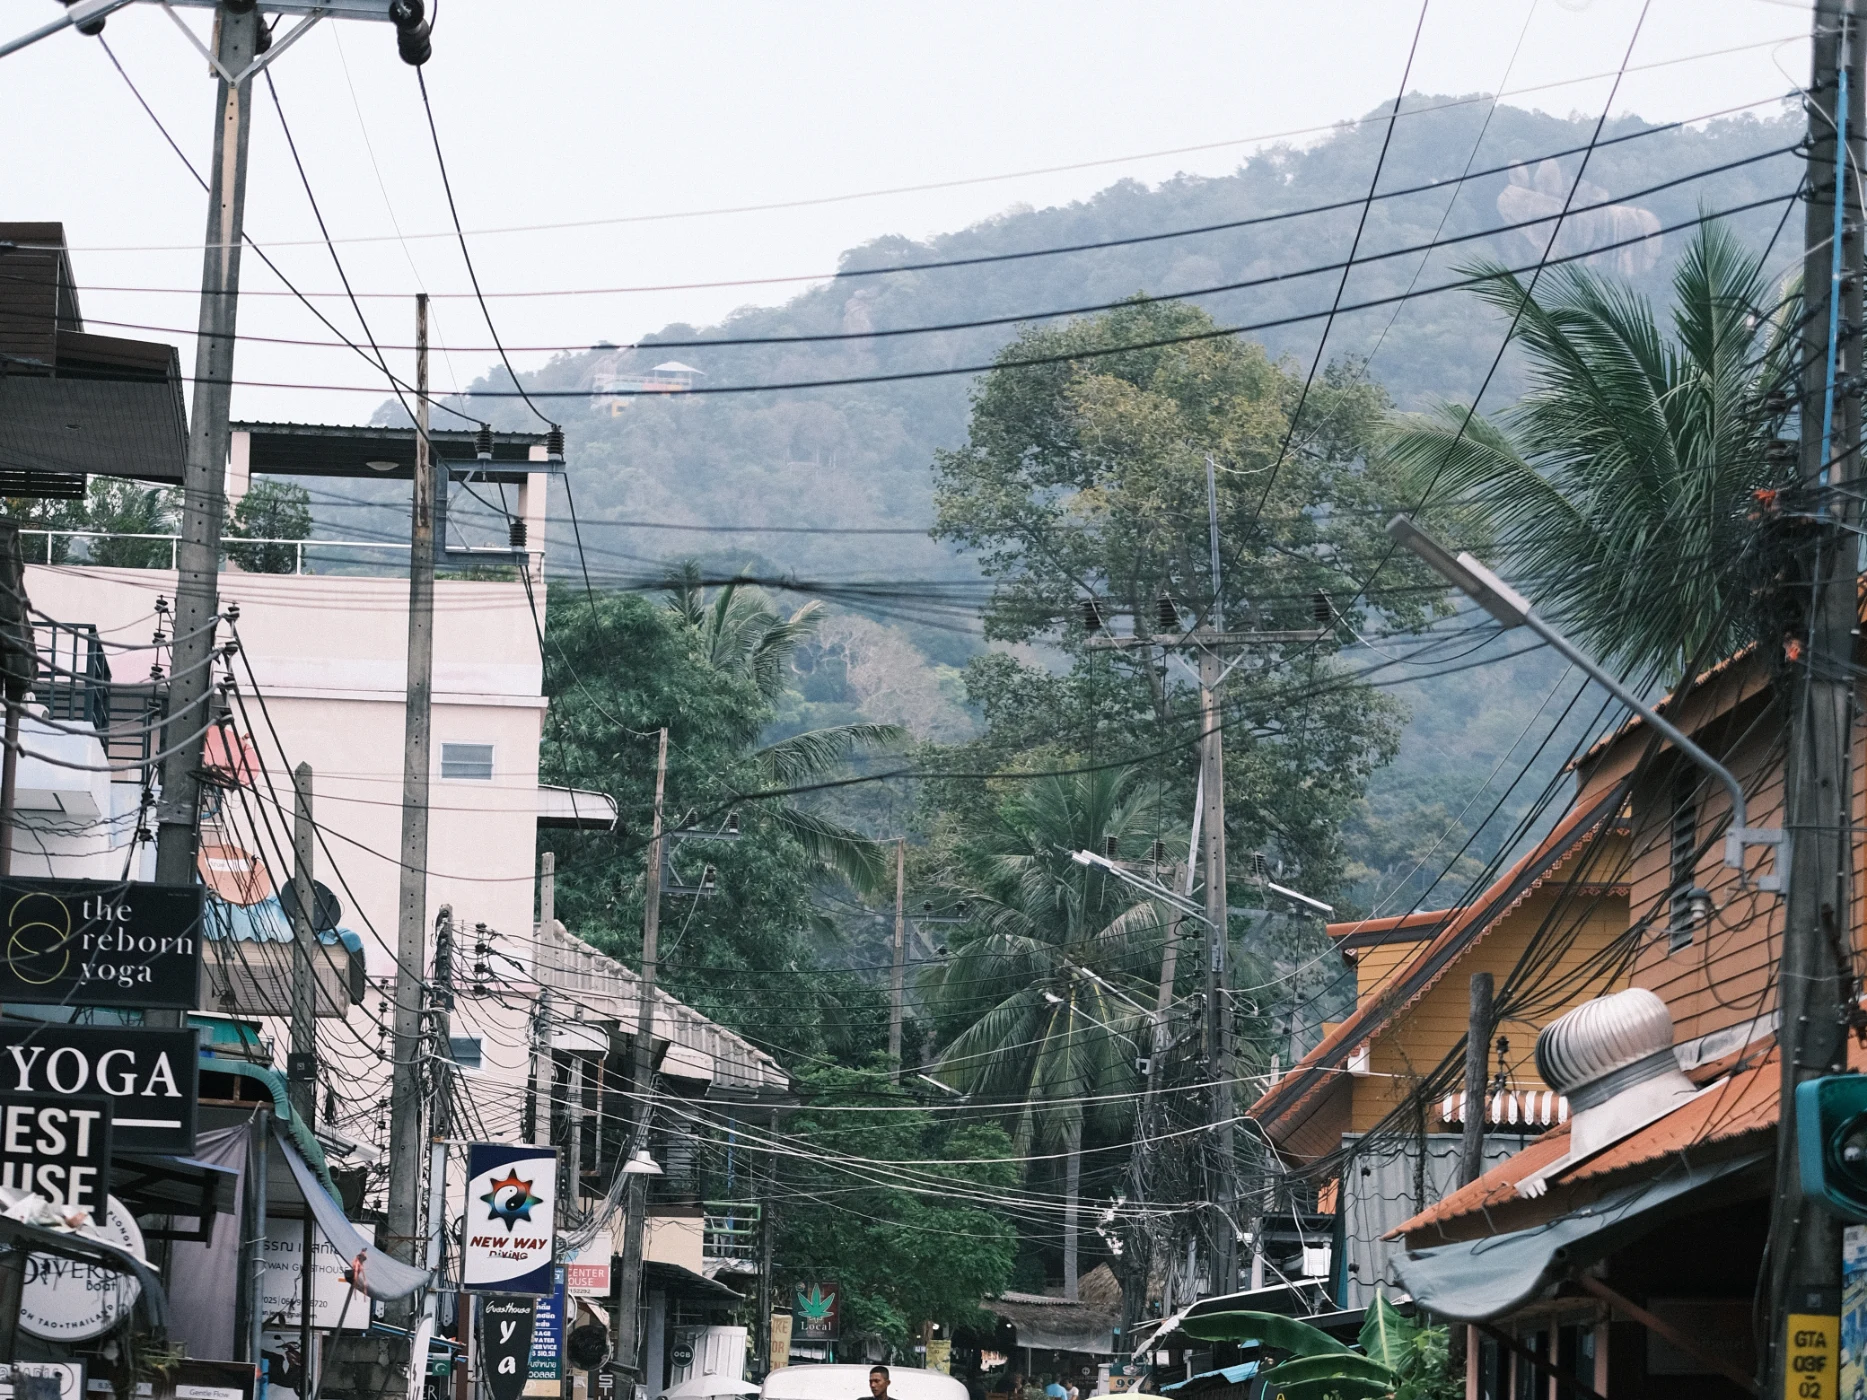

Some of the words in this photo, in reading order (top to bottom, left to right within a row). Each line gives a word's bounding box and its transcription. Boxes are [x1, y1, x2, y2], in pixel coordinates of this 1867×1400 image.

[83, 896, 132, 922] the
[82, 927, 193, 955] reborn
[80, 963, 153, 988] yoga
[6, 1045, 183, 1098] YOGA
[0, 1105, 101, 1158] EST
[470, 1236, 510, 1250] NEW
[514, 1237, 548, 1250] WAY
[568, 1278, 594, 1286] OUSE
[20, 1308, 34, 1321] OH
[38, 1317, 57, 1329] TAO
[801, 1321, 832, 1331] Local
[771, 1341, 785, 1354] OR
[1794, 1330, 1827, 1348] GTA
[673, 1350, 691, 1358] OCB
[189, 1388, 213, 1398] Gentle
[215, 1390, 230, 1398] Flow
[1798, 1381, 1822, 1399] 02
